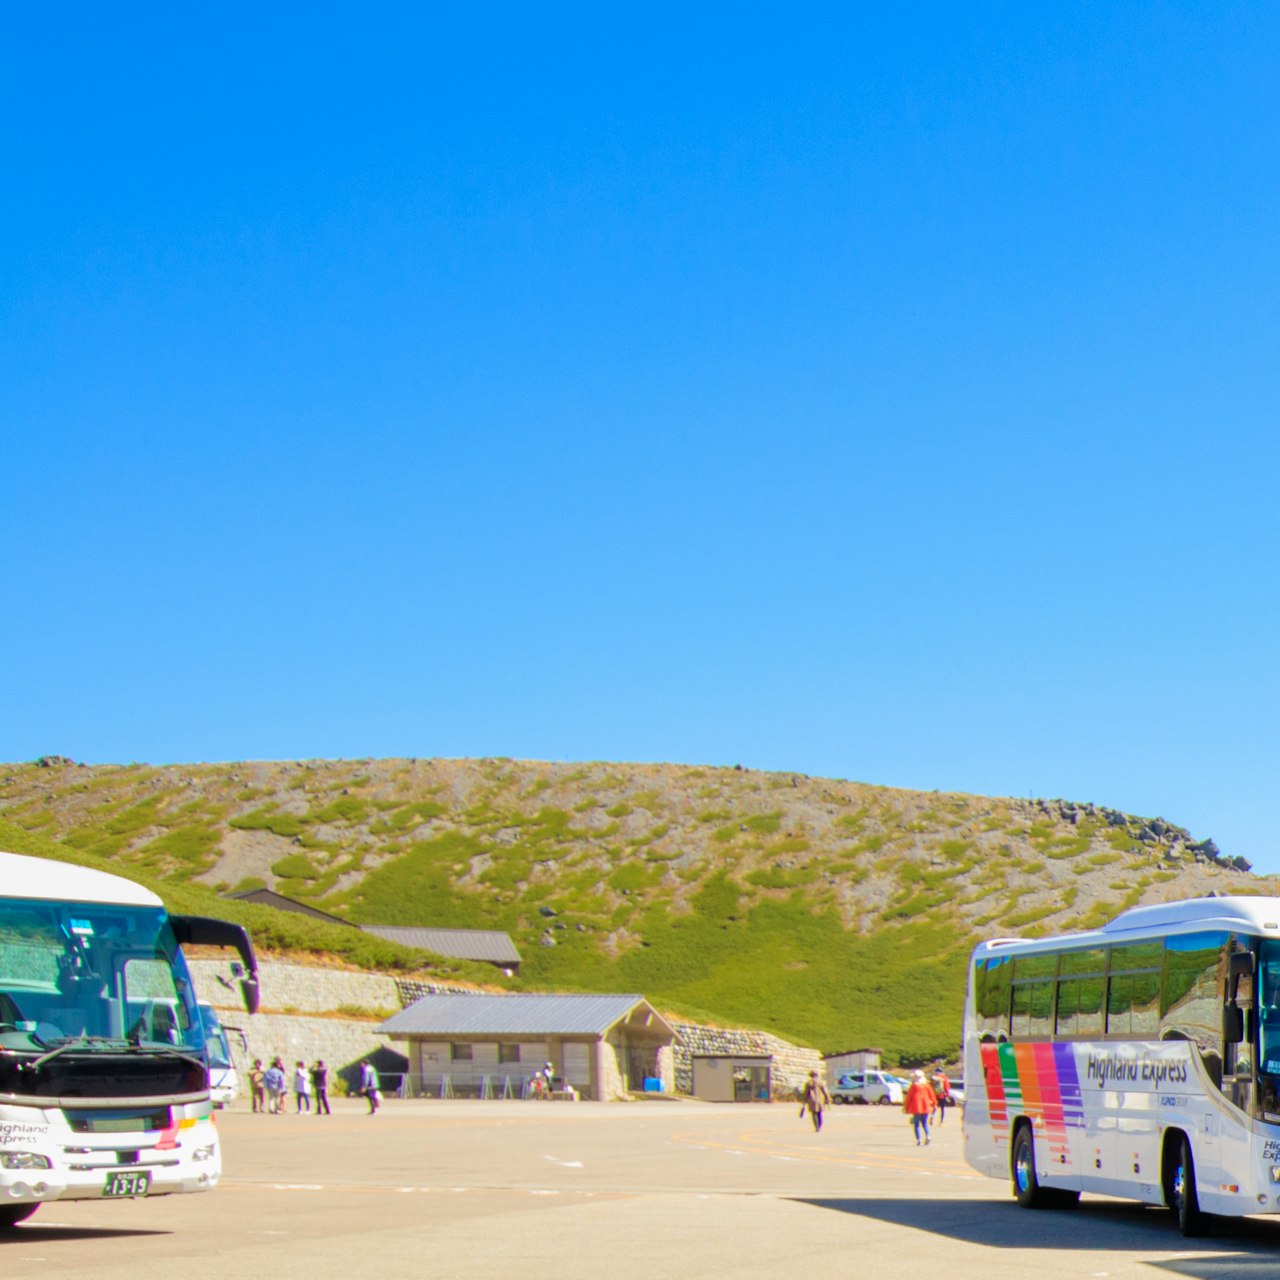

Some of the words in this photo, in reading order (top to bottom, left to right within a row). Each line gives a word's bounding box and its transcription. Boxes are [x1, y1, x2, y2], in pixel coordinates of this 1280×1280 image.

[1088, 1053, 1138, 1089] Highland
[1142, 1055, 1188, 1089] Express
[0, 1123, 48, 1135] ighland
[0, 1135, 37, 1146] xpress
